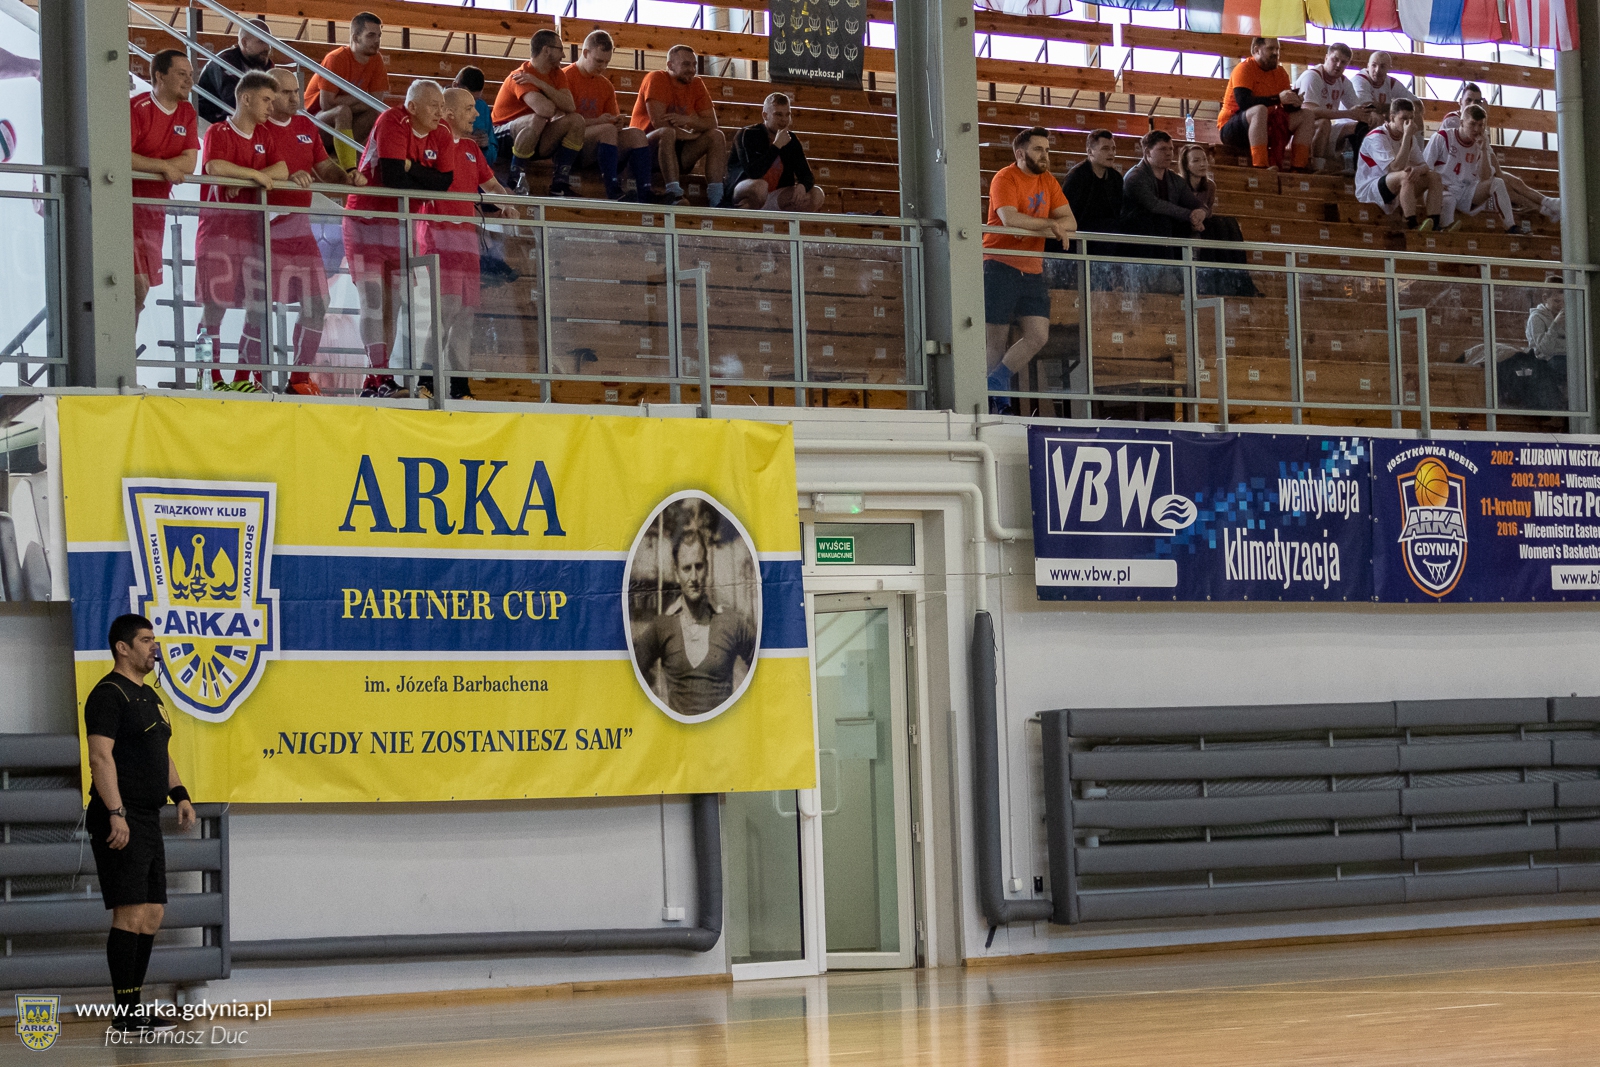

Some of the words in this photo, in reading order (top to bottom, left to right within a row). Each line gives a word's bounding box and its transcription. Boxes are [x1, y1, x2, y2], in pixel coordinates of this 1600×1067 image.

[788, 67, 844, 80] www.pzkosz.pl
[1453, 162, 1462, 176] 4
[1386, 445, 1446, 472] KOSZYKÓWKA
[1448, 450, 1478, 474] KOBIET
[1490, 450, 1514, 465] 2002
[1520, 448, 1567, 466] KLUBOWY
[1051, 444, 1161, 532] VBW
[1511, 472, 1537, 488] 2002,
[1537, 472, 1560, 488] 2004
[338, 454, 567, 537] ARKA
[1278, 468, 1360, 520] wentylacja
[1480, 498, 1531, 518] 11-krotny
[1534, 491, 1583, 517] Mistrz
[154, 504, 214, 517] ZWIĄZKOWY
[217, 507, 247, 517] KLUB
[1404, 510, 1464, 537] ARKA
[1497, 521, 1518, 536] 2016
[1524, 523, 1574, 538] Wicemistrz
[819, 540, 851, 550] WYJŚCIE
[1414, 542, 1459, 556] GDYNIA
[1519, 544, 1562, 559] Women's
[150, 533, 164, 585] MORSKI
[243, 524, 255, 597] SPORTOWY
[1224, 527, 1340, 590] klimatyzacja
[1050, 566, 1131, 585] www.vbw.pl
[342, 588, 494, 620] PARTNER
[503, 590, 567, 620] CUP
[164, 610, 252, 636] ARKA
[169, 646, 248, 698] GDYNIA
[364, 676, 390, 693] im.
[396, 675, 448, 693] Józefa
[453, 676, 549, 692] Barbachena
[370, 731, 414, 754] NIE
[421, 729, 568, 754] ZOSTANIESZ
